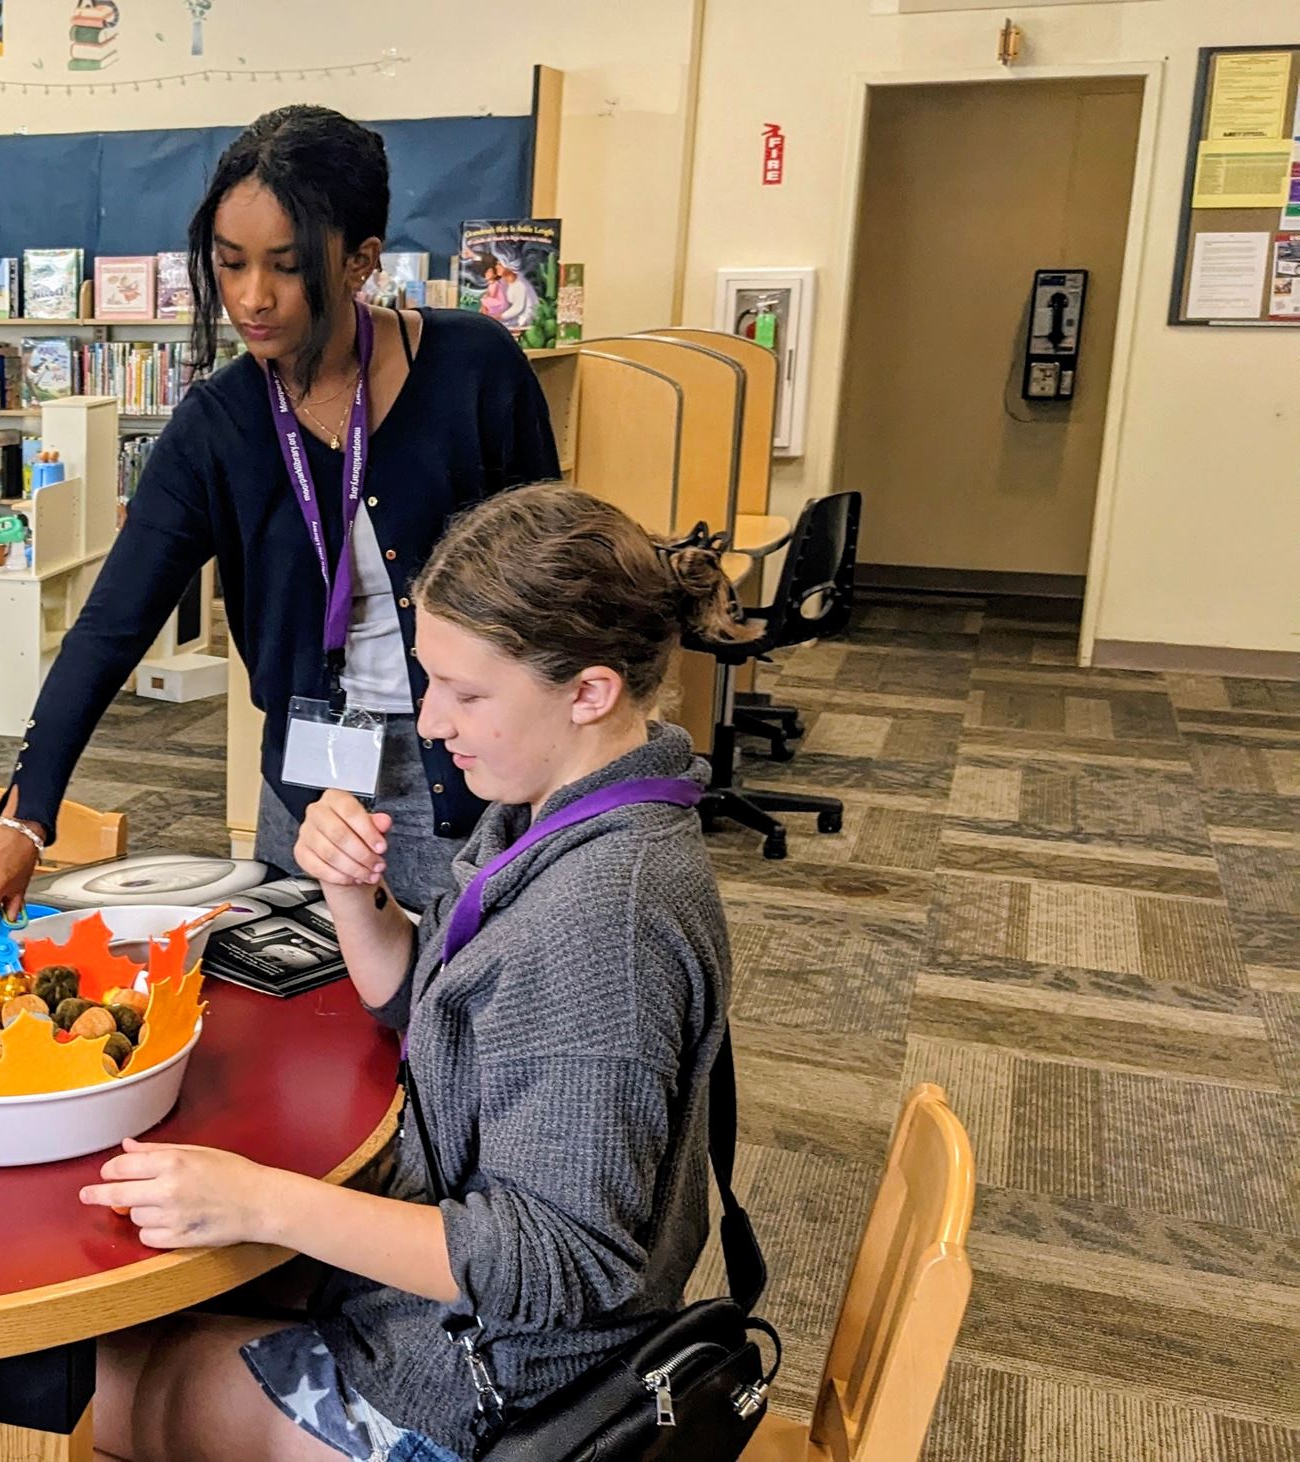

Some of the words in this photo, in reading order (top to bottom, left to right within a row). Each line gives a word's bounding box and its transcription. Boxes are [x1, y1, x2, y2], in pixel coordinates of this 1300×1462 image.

[765, 137, 782, 181] FIRE
[286, 432, 311, 501] moorparklibrary.org
[349, 427, 361, 500] moorparklibrary.org
